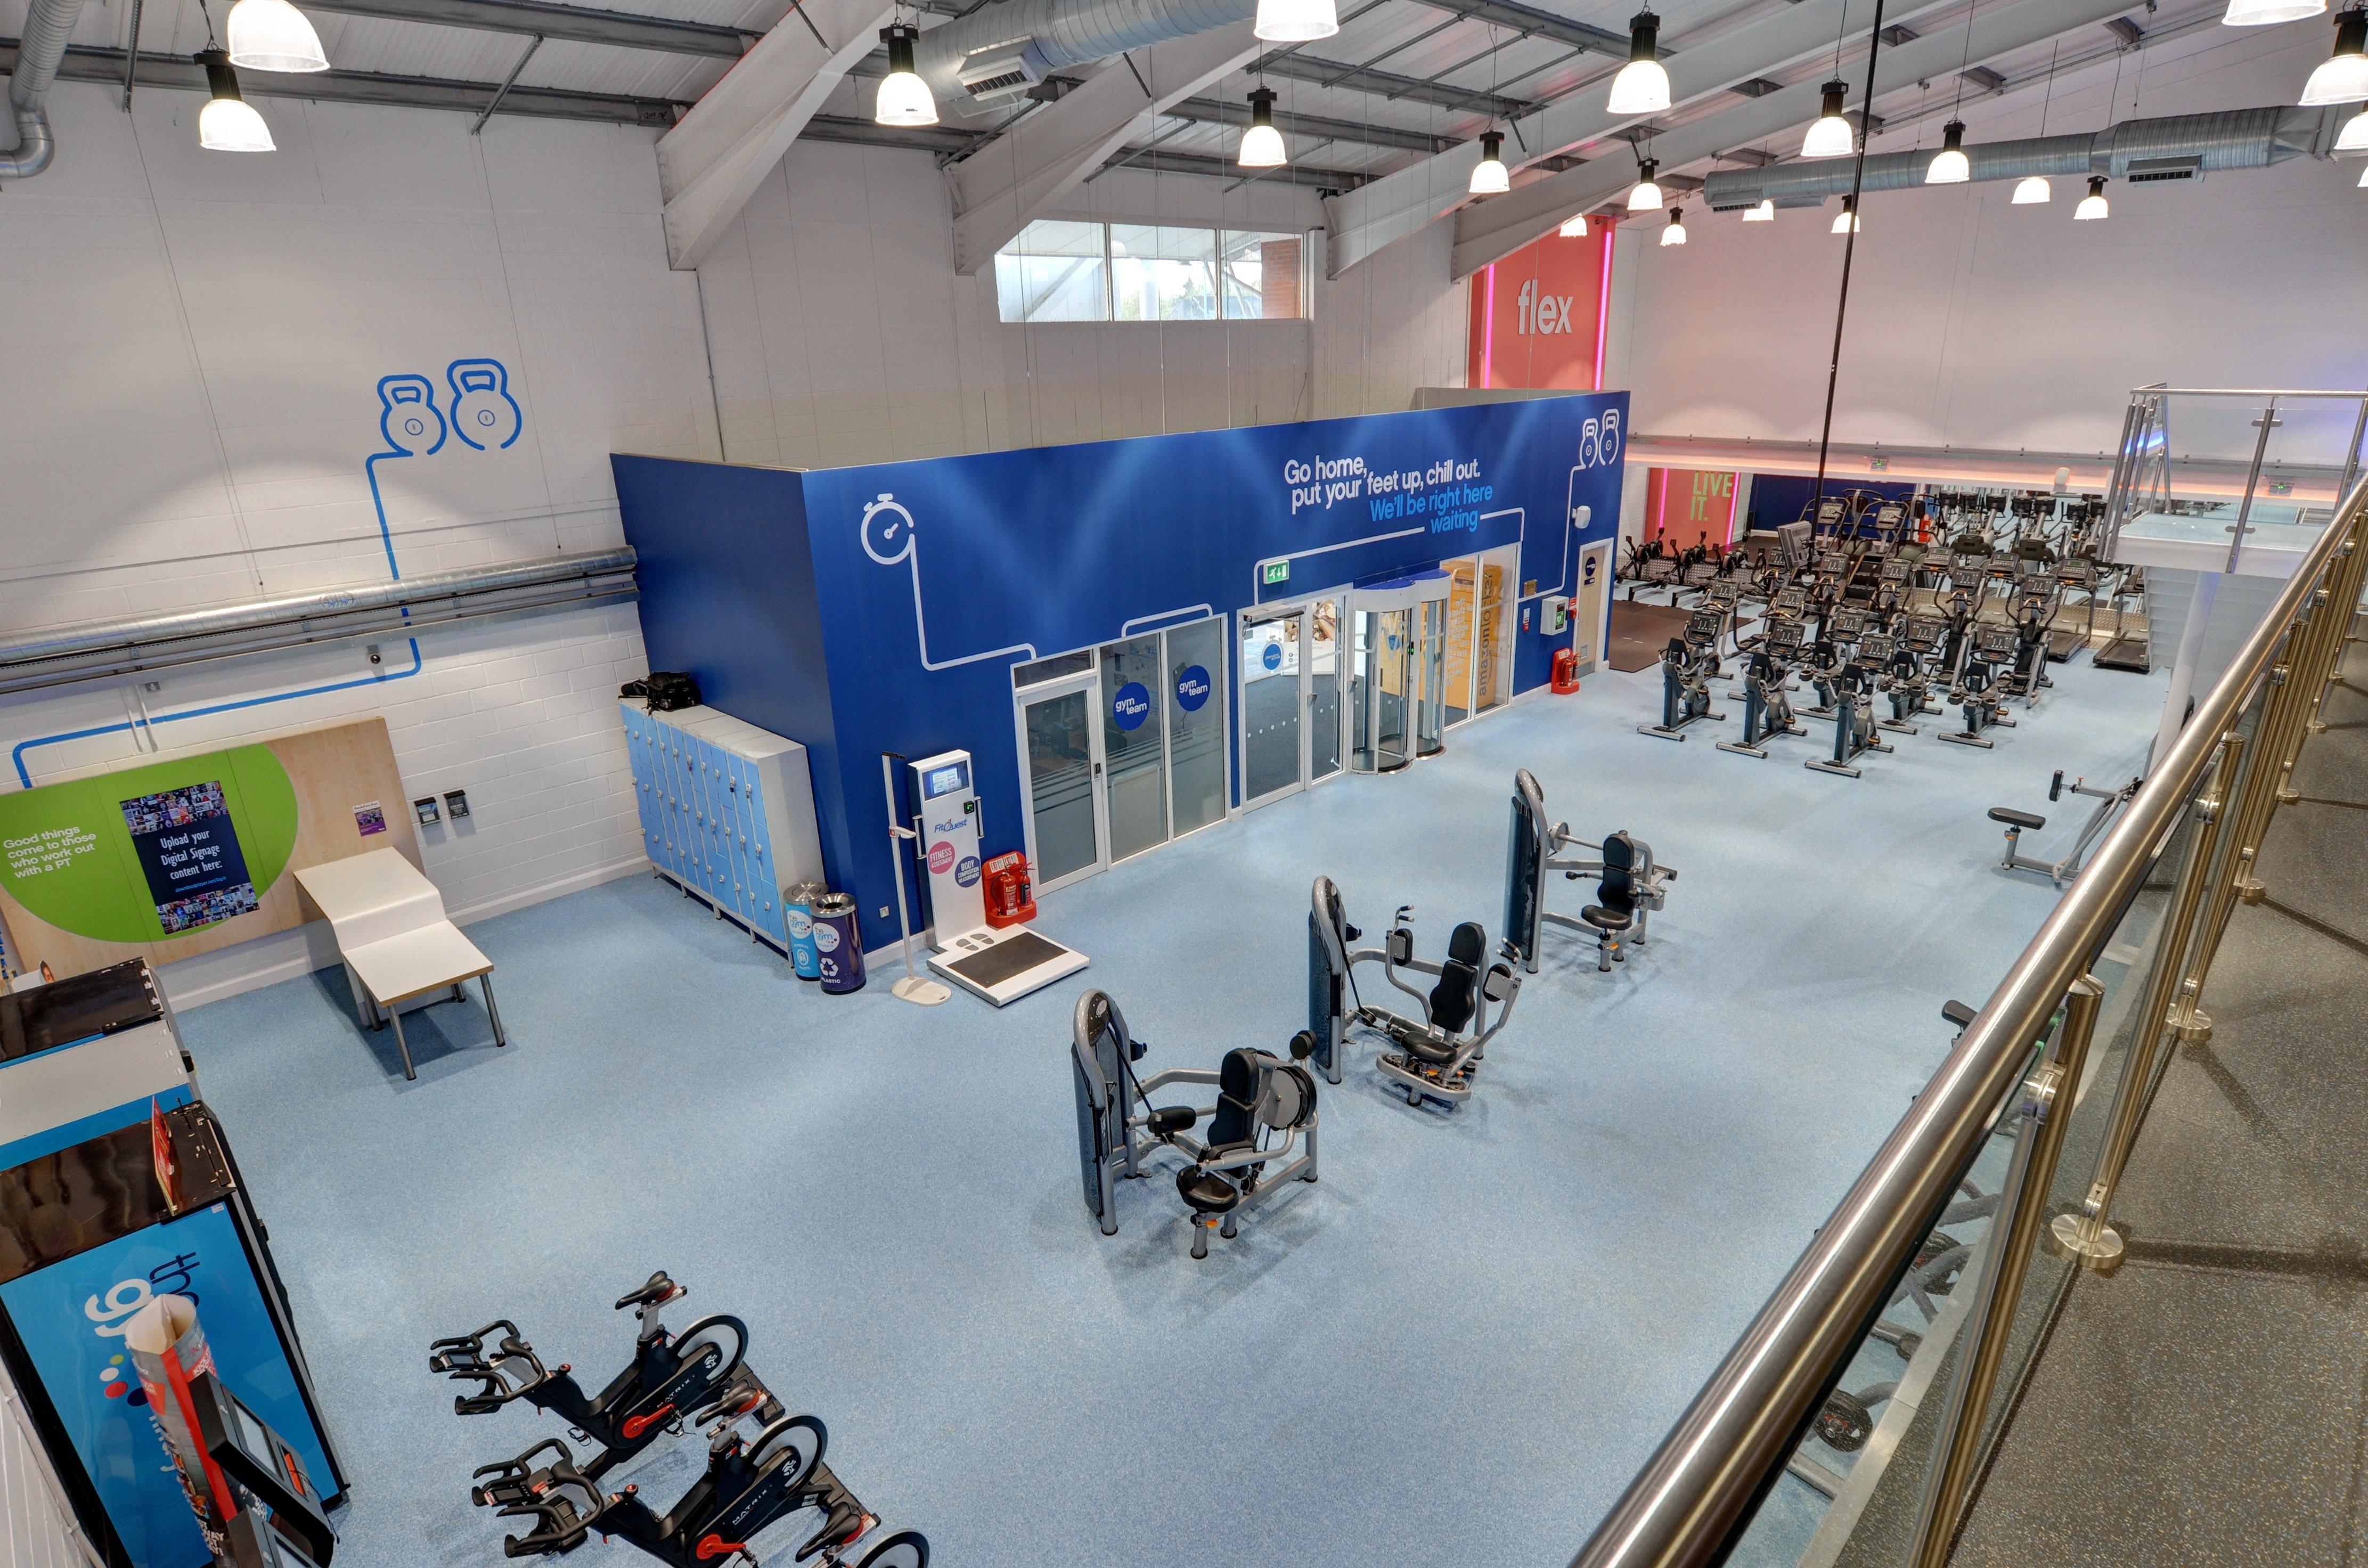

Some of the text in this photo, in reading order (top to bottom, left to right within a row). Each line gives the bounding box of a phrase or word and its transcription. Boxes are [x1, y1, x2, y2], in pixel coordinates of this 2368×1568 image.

[1517, 279, 1574, 335] flex
[1284, 455, 1367, 484] Go home,
[1292, 459, 1481, 515] put your feet up, chill out.
[1693, 472, 1734, 498] LIVE
[1369, 483, 1493, 522] We'll be right here
[1690, 496, 1709, 521] IT.
[1430, 508, 1479, 534] waiting
[1179, 679, 1196, 693] gym
[1189, 684, 1208, 697] team
[1115, 697, 1134, 713] gym
[1126, 702, 1147, 715] team
[934, 819, 967, 832] FitQuest
[3, 827, 80, 848] Good things
[7, 845, 44, 859] come
[61, 834, 96, 846] those
[160, 831, 210, 851] Upload your
[10, 843, 95, 869] who work out
[160, 845, 221, 867] Digital Signage
[930, 847, 952, 862] FITNESS
[931, 856, 953, 868] ASSESSMENT
[14, 866, 42, 878] with
[55, 858, 71, 869] PT
[170, 860, 223, 879] content here:
[958, 867, 979, 878] COMPOSITION
[961, 860, 974, 872] BODY
[958, 872, 979, 884] MEASUREMENT
[816, 933, 833, 942] gym
[732, 1489, 767, 1524] MATRIX
